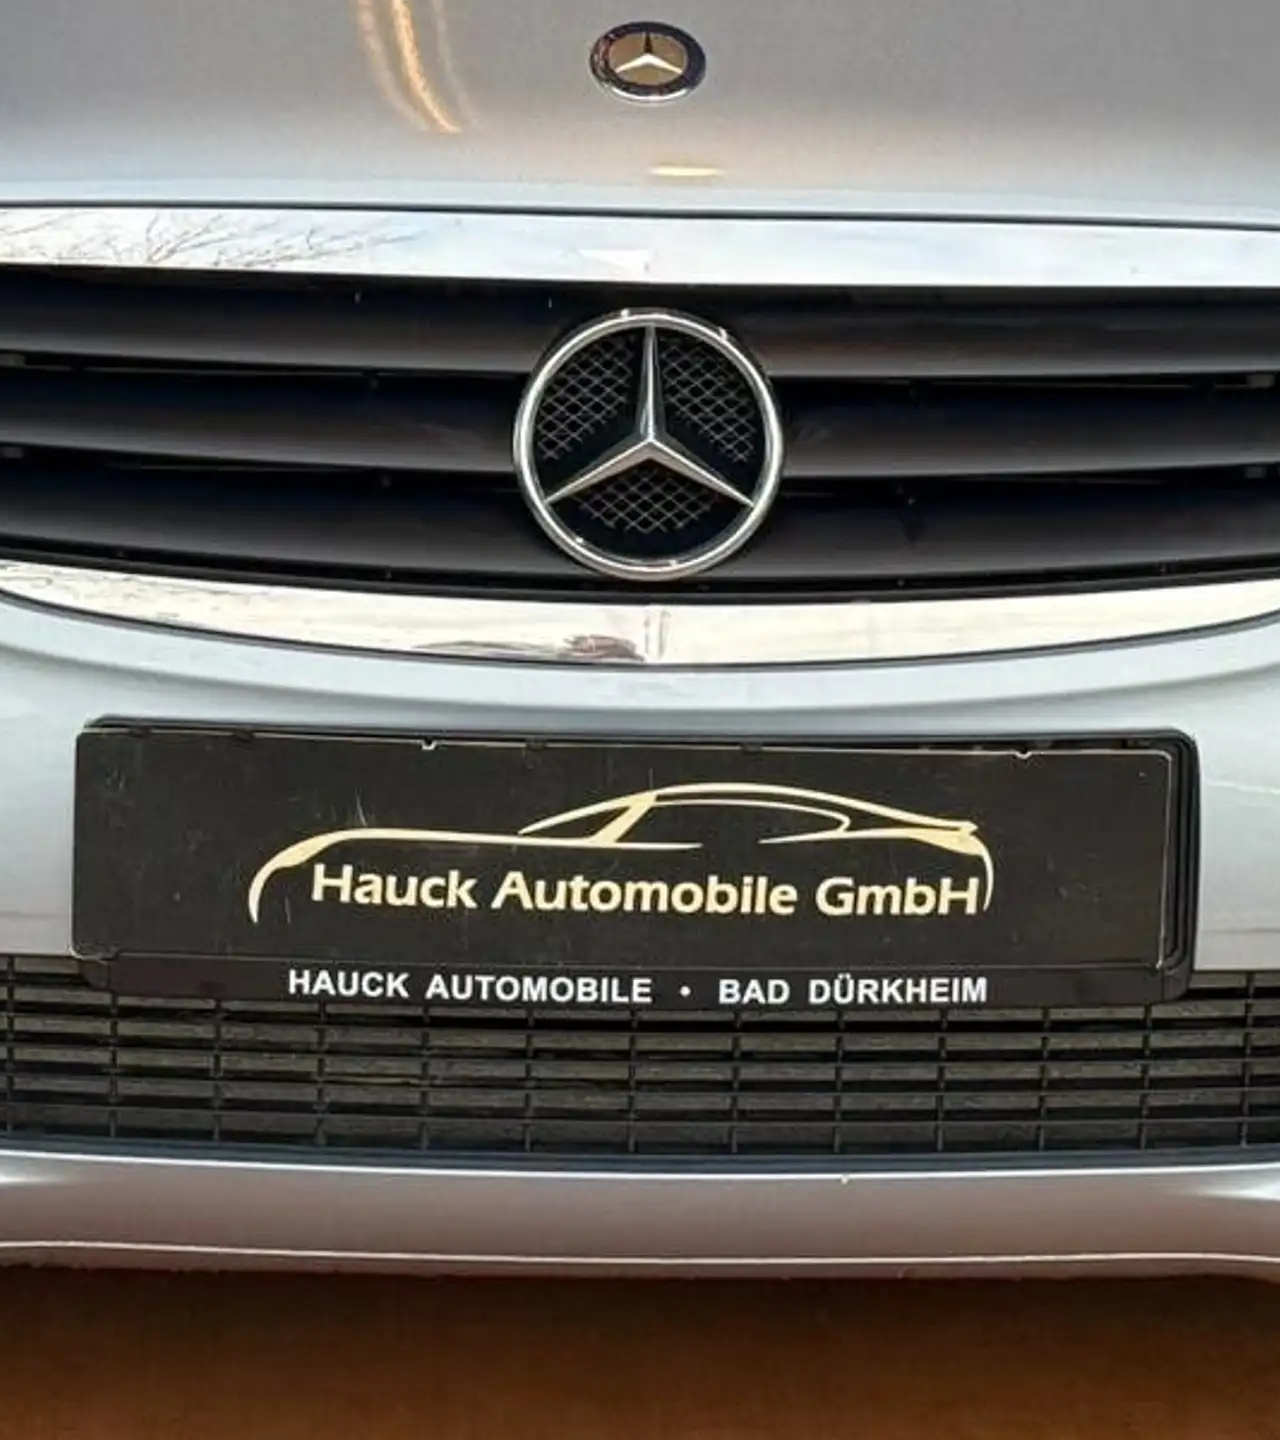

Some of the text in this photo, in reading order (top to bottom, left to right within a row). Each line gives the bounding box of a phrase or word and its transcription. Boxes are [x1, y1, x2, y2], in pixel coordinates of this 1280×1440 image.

[311, 863, 980, 916] Hauck Automobile GmbH
[288, 969, 988, 1004] HAUCK AUTOMOBILE BAD DÜRKHEIM
